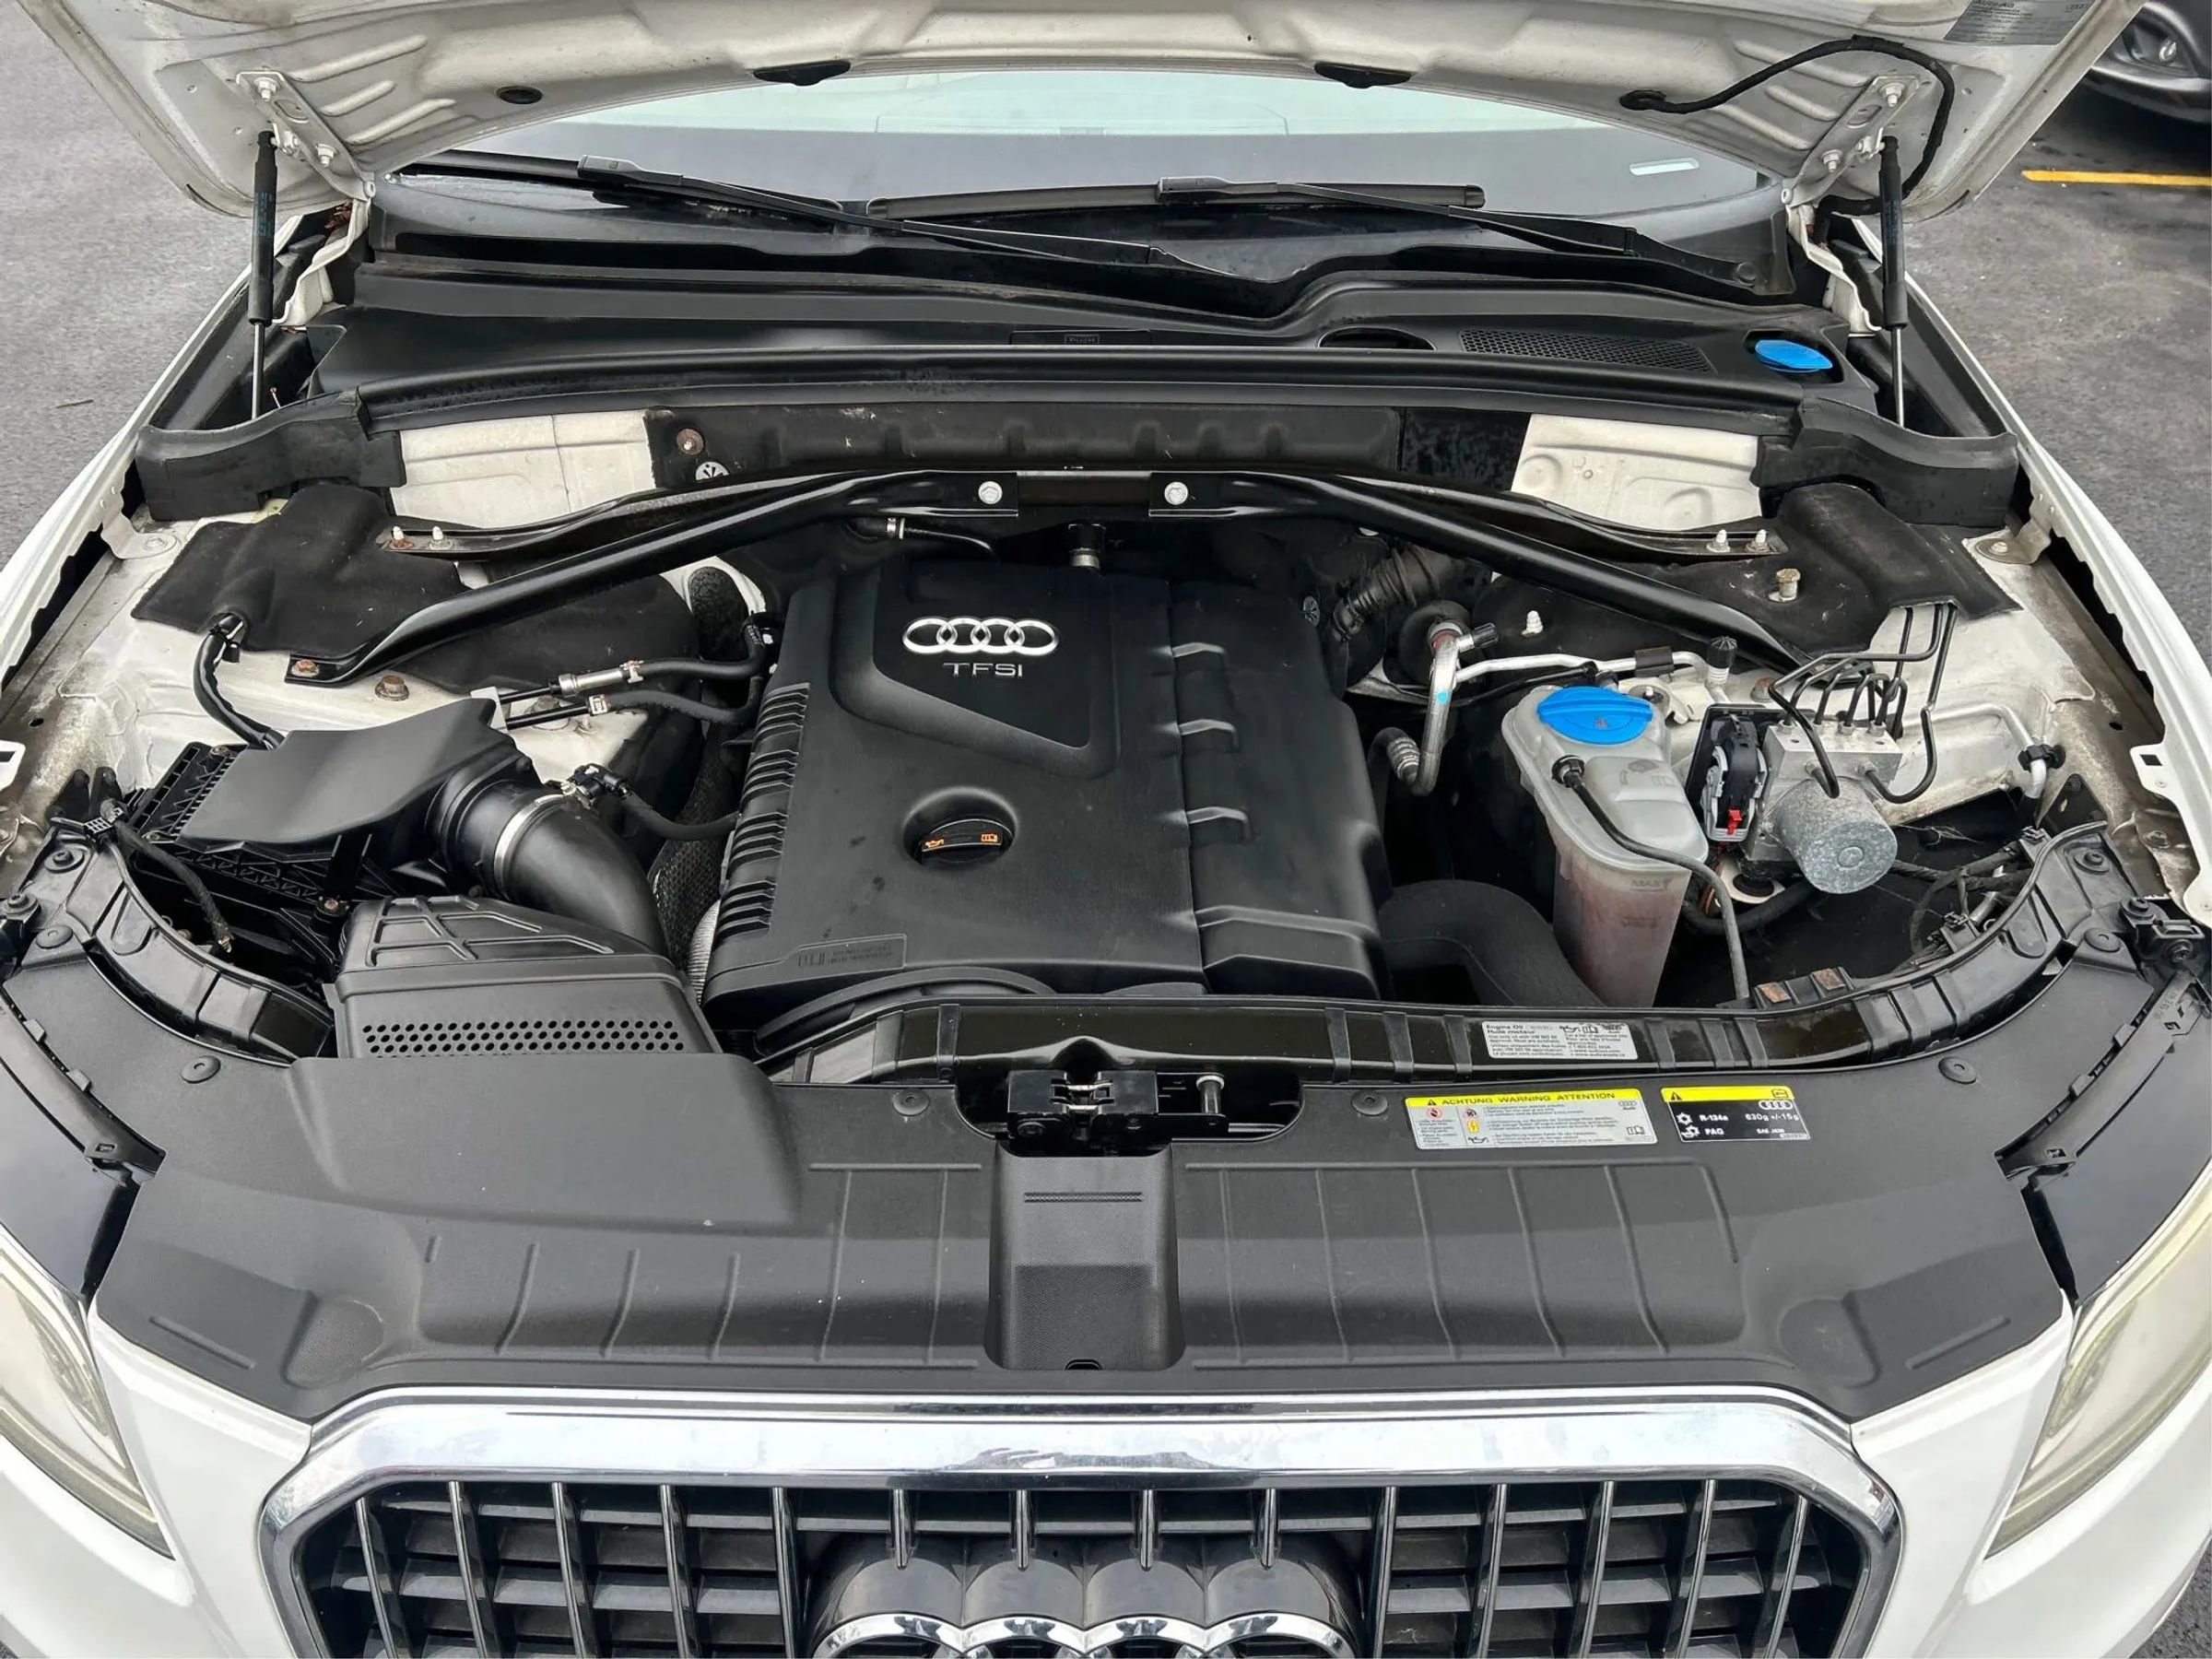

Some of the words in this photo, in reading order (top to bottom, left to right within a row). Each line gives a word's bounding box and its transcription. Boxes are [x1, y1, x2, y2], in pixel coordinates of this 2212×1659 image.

[942, 662, 1023, 678] TFSI
[1498, 1095, 1551, 1104] WARNING
[1557, 1092, 1616, 1101] ATTENTION
[1704, 1127, 1724, 1135] PAG
